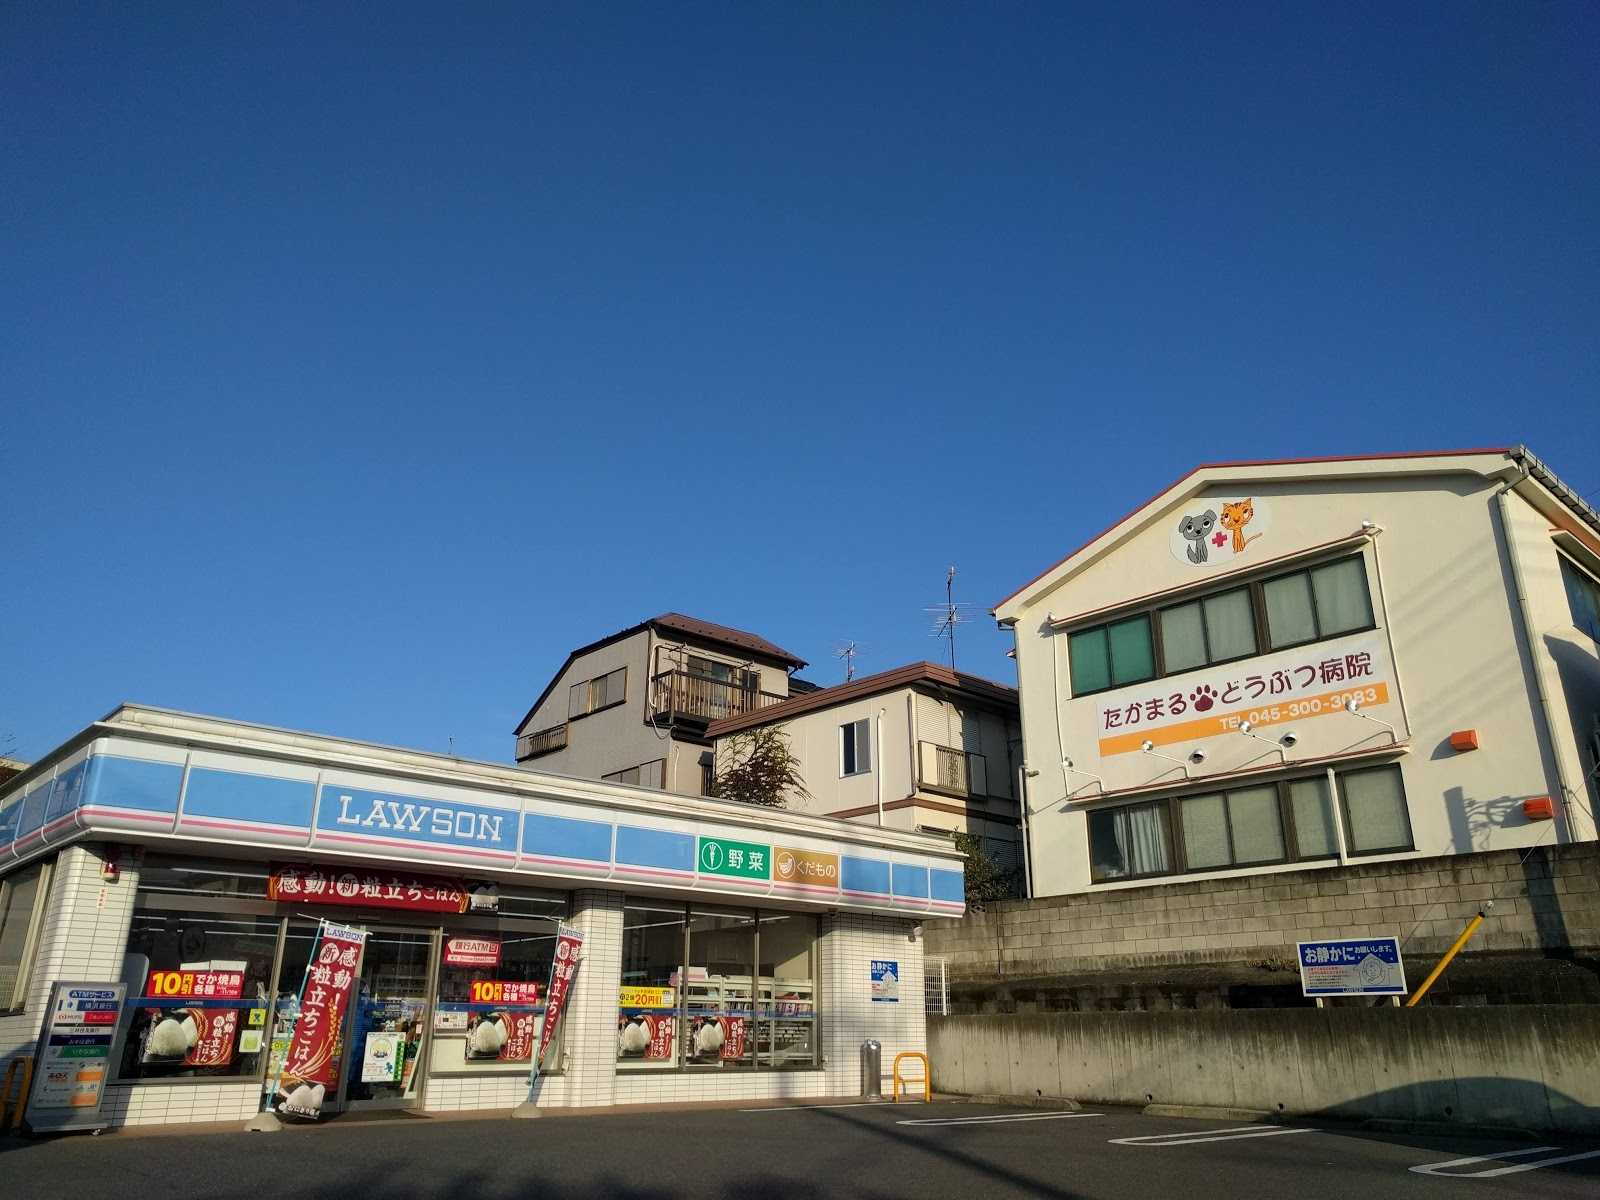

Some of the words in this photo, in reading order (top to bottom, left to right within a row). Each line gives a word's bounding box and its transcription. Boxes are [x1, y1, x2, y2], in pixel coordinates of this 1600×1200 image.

[1103, 694, 1187, 730] たかまる
[1220, 651, 1374, 705] どうぶつ病院
[336, 794, 504, 841] LAWSON
[728, 848, 764, 872] 野菜
[796, 860, 837, 878] くだもの
[326, 926, 363, 942] LAWSON
[1305, 946, 1355, 963] お静かに
